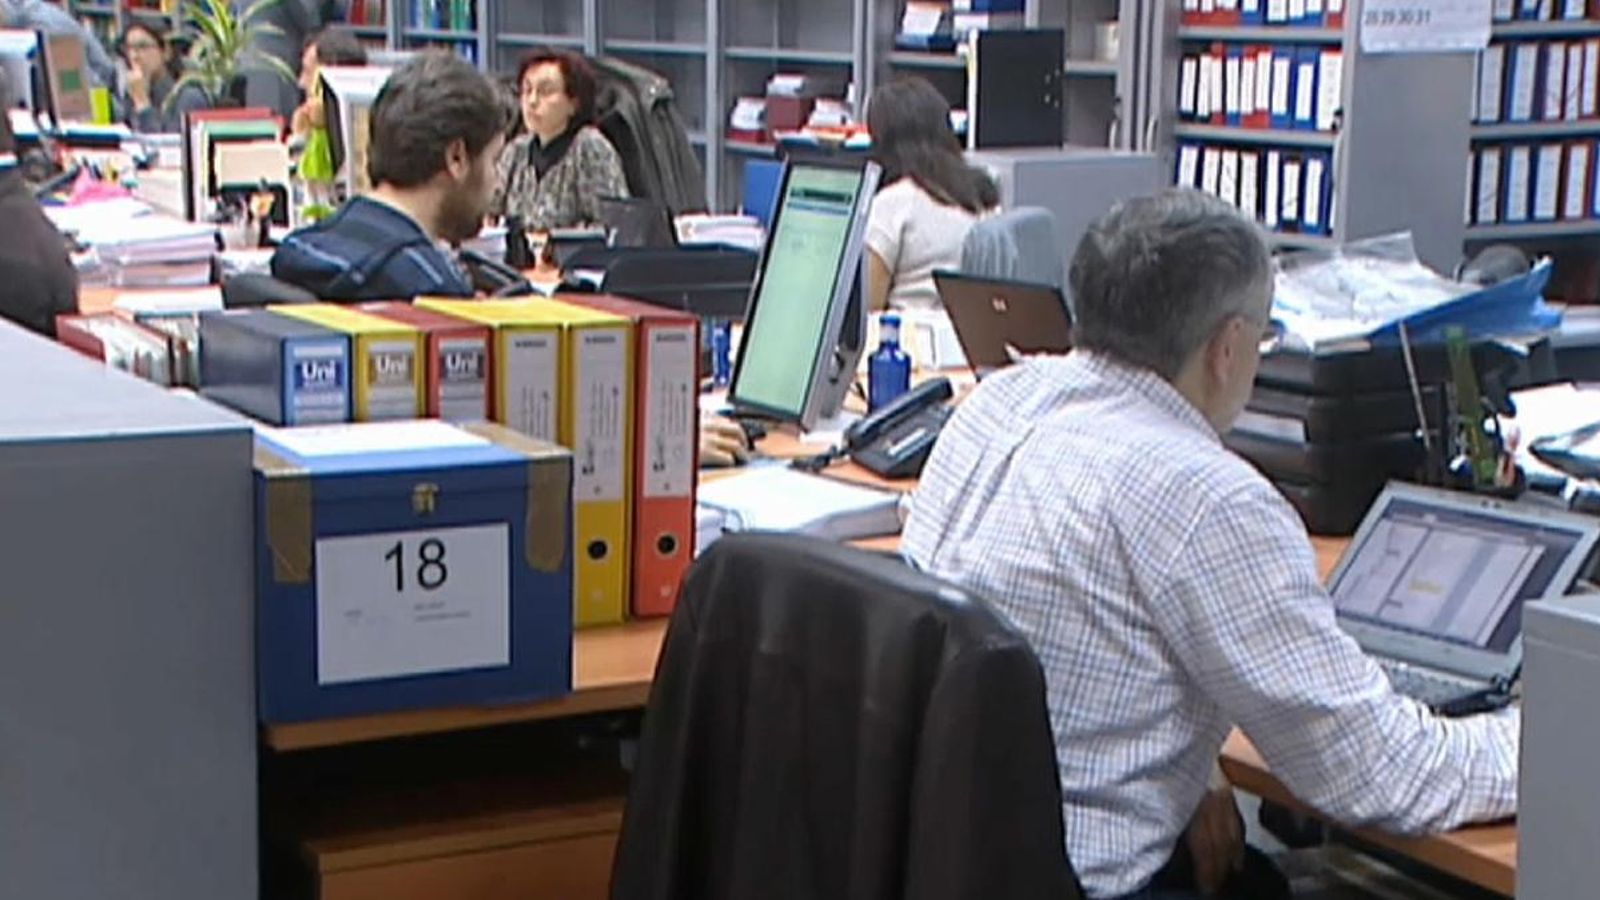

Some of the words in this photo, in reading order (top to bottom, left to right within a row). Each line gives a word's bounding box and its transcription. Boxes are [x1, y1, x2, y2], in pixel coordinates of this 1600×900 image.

[302, 359, 335, 381] Uni
[375, 353, 407, 373] Uni
[446, 352, 478, 371] Uni
[384, 537, 447, 592] 18
